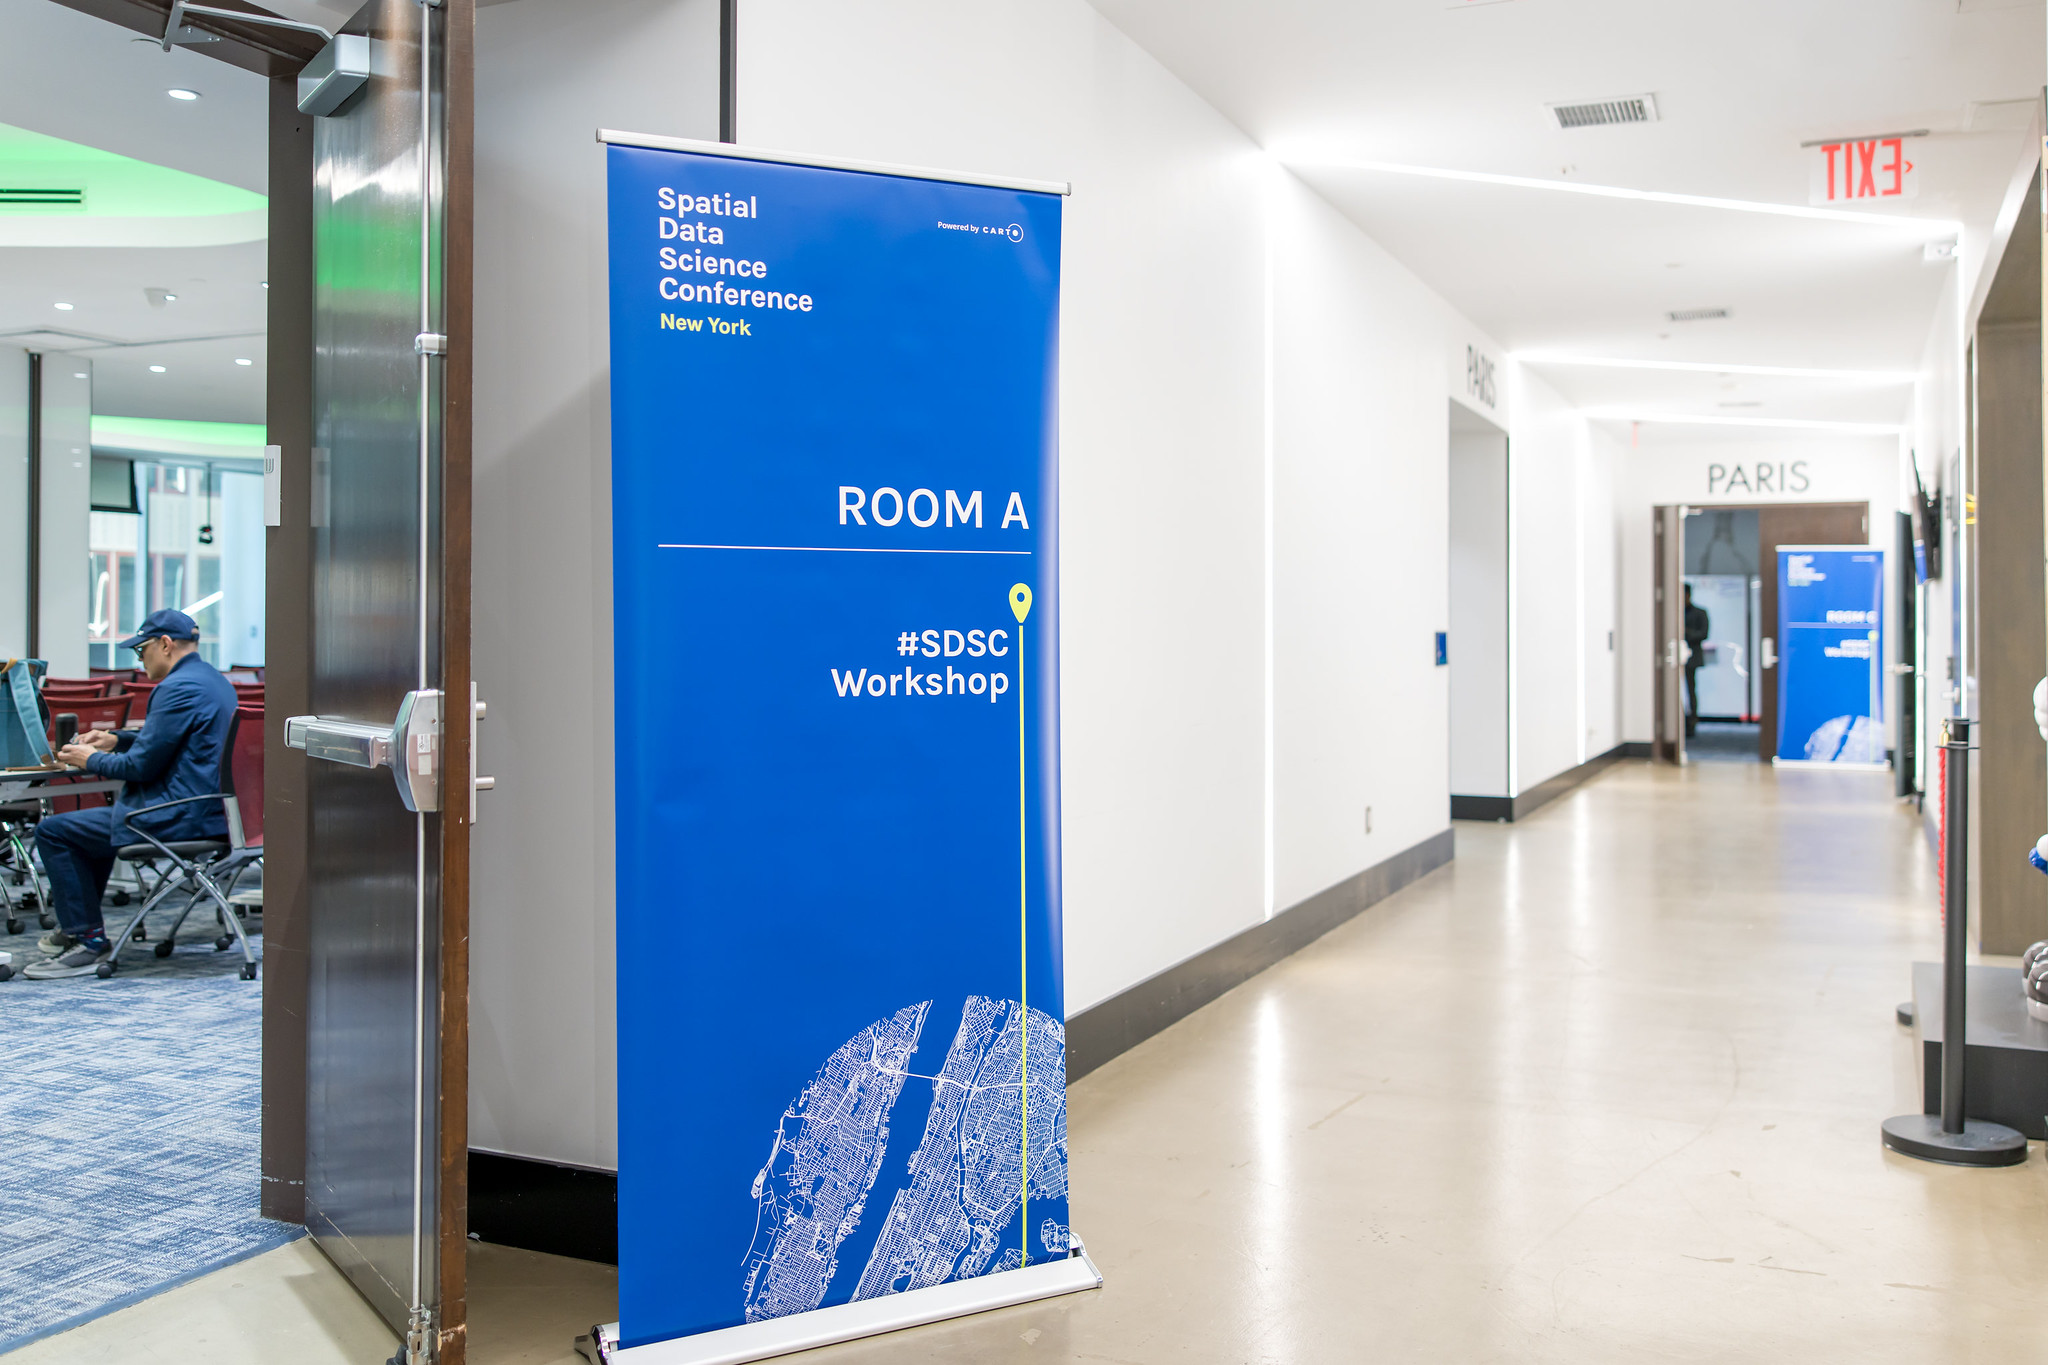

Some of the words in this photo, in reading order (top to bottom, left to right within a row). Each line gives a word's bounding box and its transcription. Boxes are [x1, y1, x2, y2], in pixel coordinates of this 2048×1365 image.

[658, 187, 757, 219] Spatial
[659, 216, 724, 245] Data
[937, 221, 969, 232] Powered
[970, 224, 980, 234] by
[982, 223, 1024, 243] CARTO
[659, 247, 768, 279] Science
[659, 277, 813, 312] Conference
[660, 313, 703, 332] New
[707, 317, 752, 336] York
[1467, 343, 1496, 409] PARIS
[1709, 460, 1809, 493] PARIS
[838, 486, 984, 529] ROOM
[1000, 491, 1030, 530] A
[897, 629, 1009, 658] #SDSC
[830, 665, 1009, 704] Workshop
